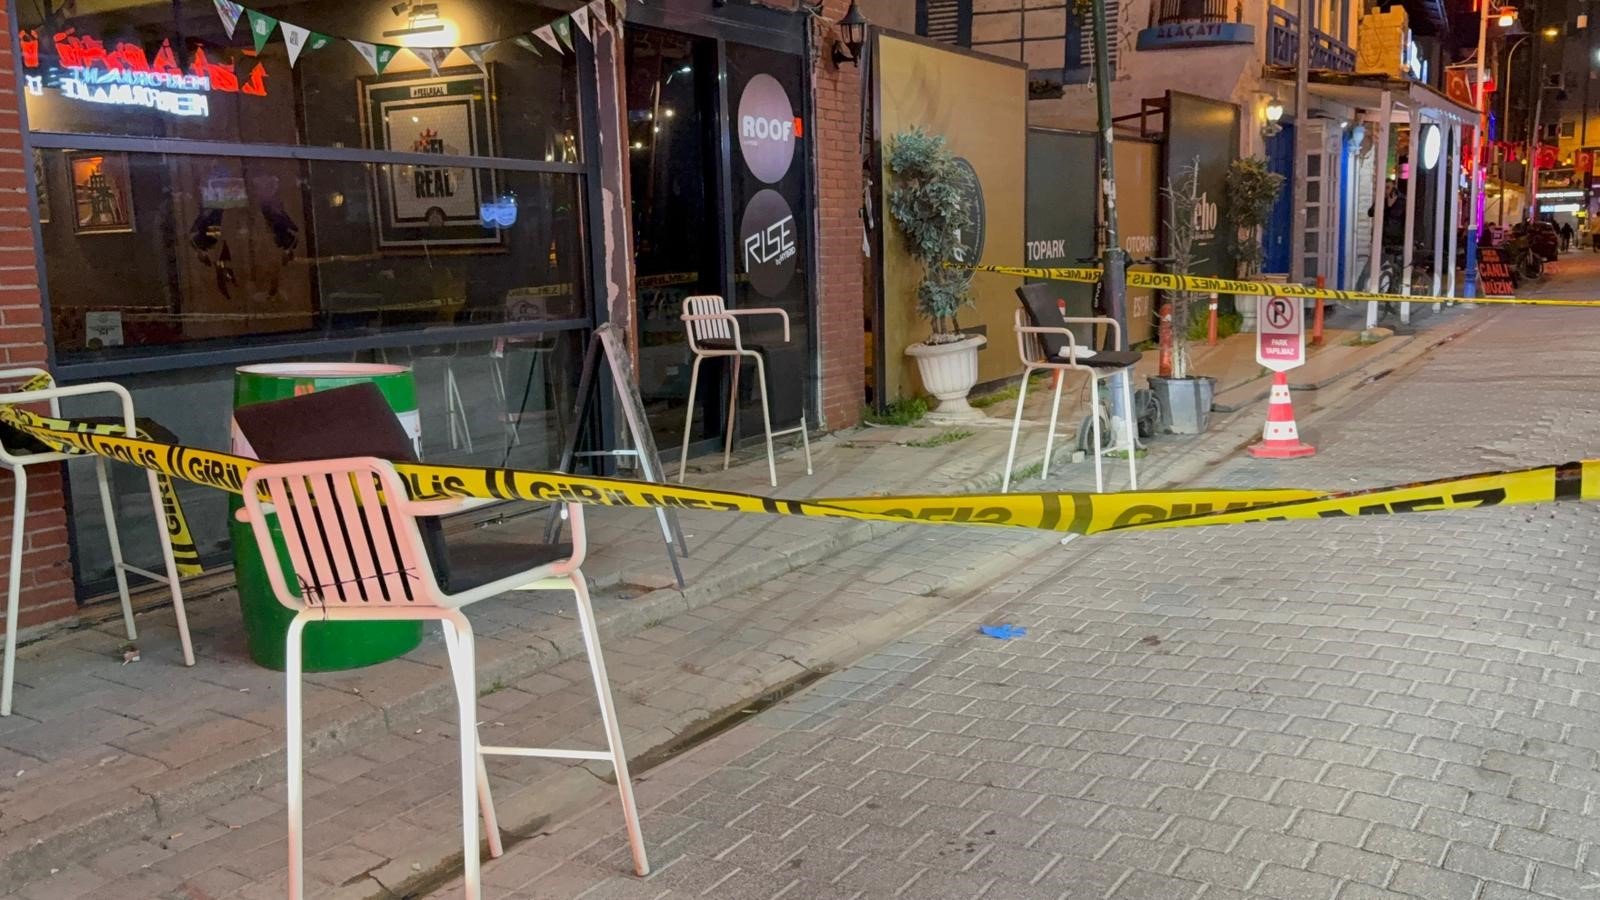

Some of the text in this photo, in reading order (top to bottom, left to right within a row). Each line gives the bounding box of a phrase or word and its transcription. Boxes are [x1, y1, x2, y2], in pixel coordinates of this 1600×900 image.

[1157, 24, 1221, 39] ALAÇATI
[743, 115, 792, 142] ROOF
[416, 168, 454, 198] REAL
[745, 215, 794, 272] RISE
[1480, 264, 1510, 278] CANLI
[1271, 338, 1288, 347] PARK
